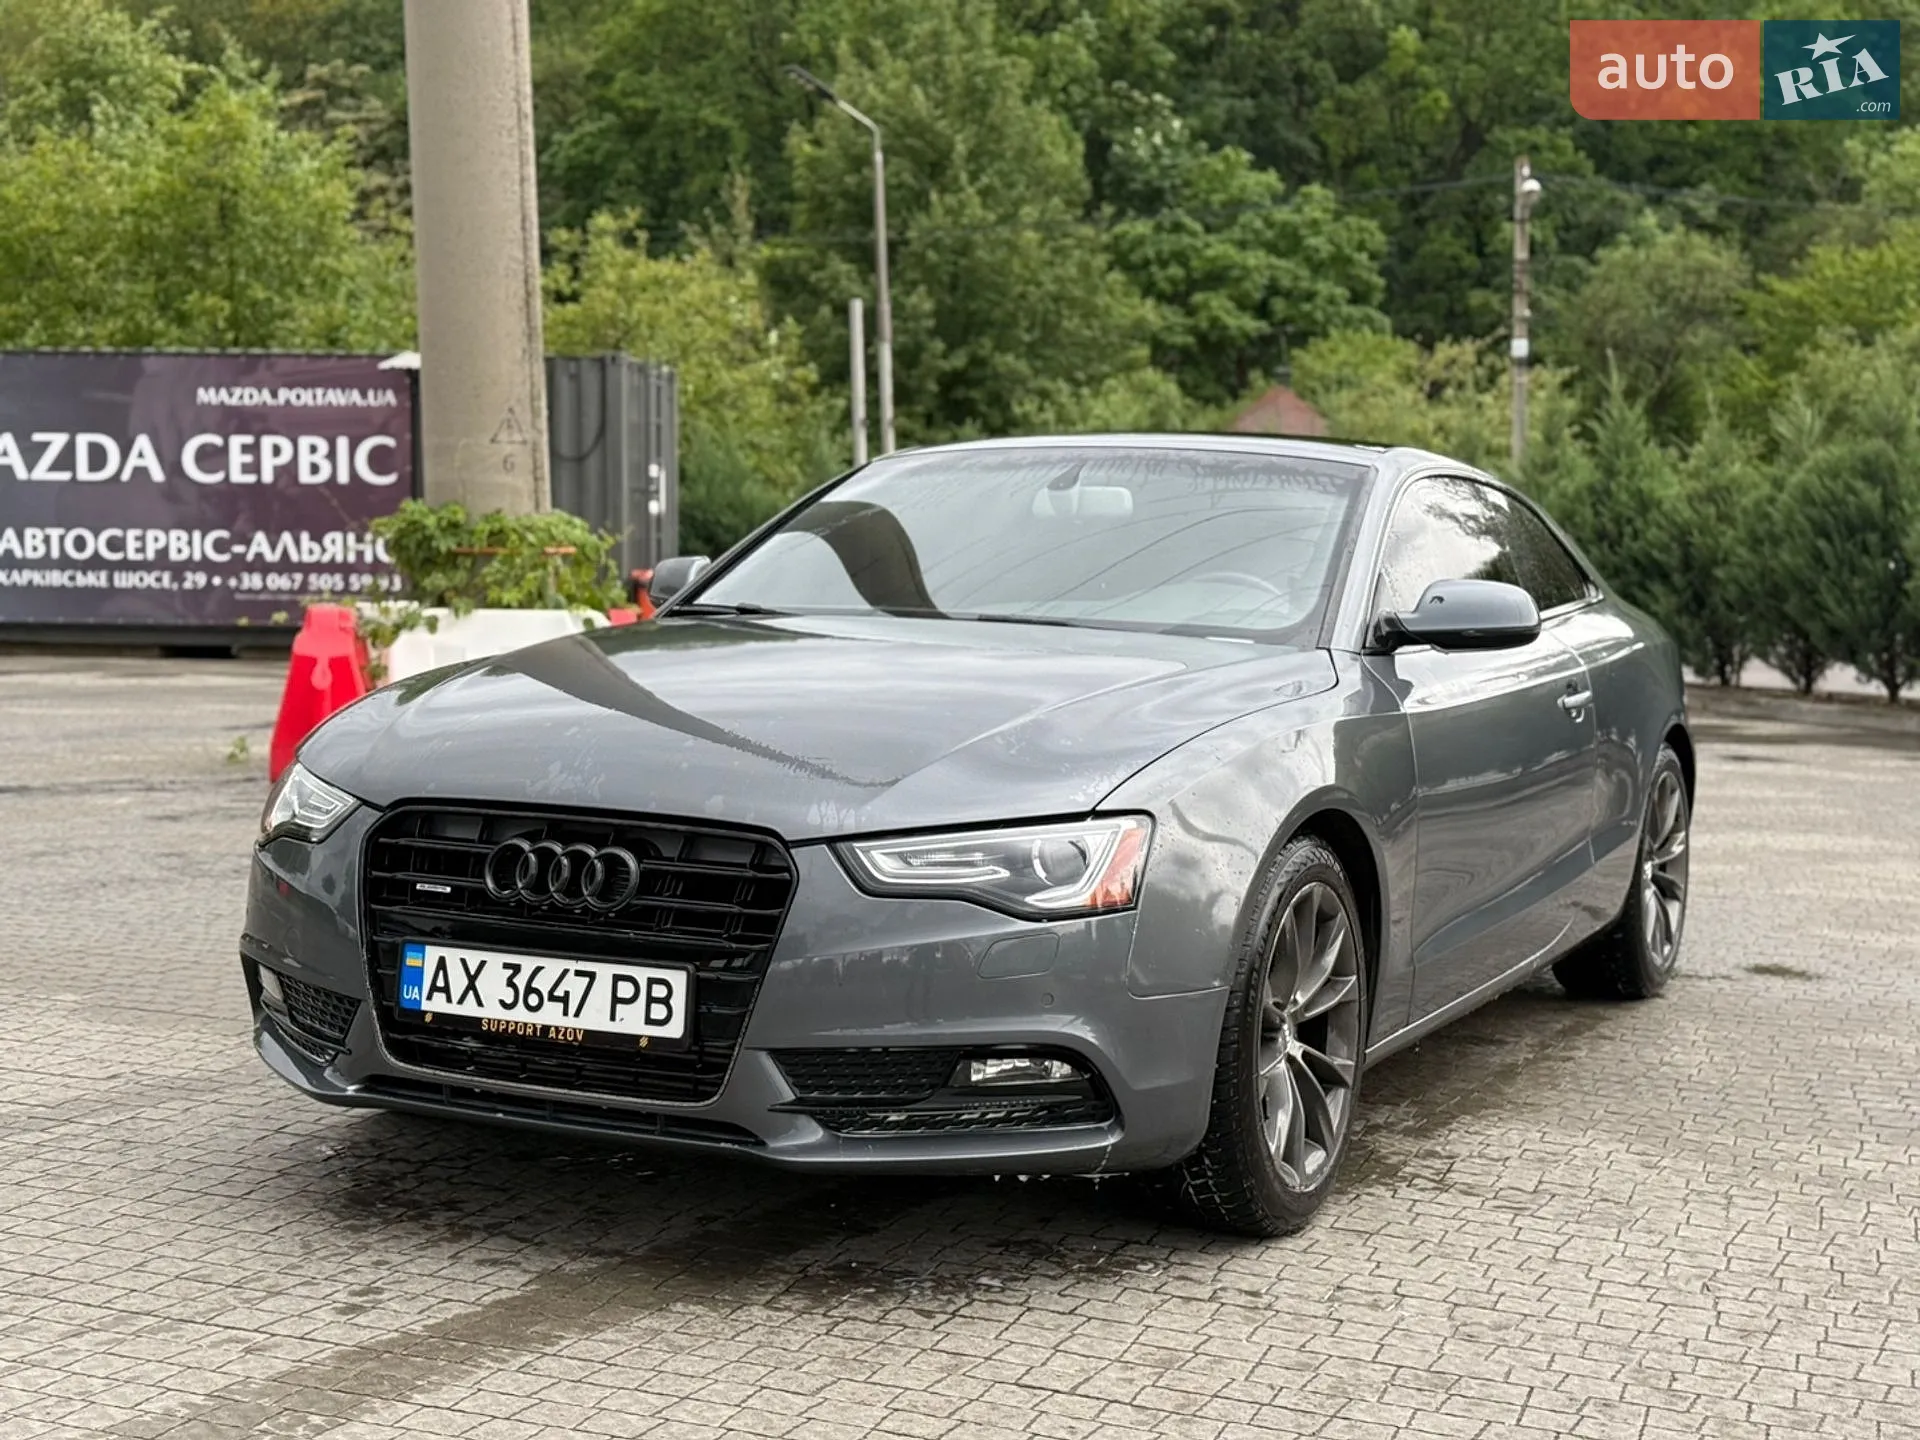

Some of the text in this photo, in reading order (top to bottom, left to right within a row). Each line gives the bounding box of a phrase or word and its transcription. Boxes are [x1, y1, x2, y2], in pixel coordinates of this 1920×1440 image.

[196, 386, 398, 407] MAZDA.POLTAVA.UA
[181, 433, 399, 485] СЕРВІС
[182, 570, 208, 590] 29
[403, 955, 674, 1028] UA AX 3647 PB
[481, 1018, 584, 1042] SUPPORT AZOV
